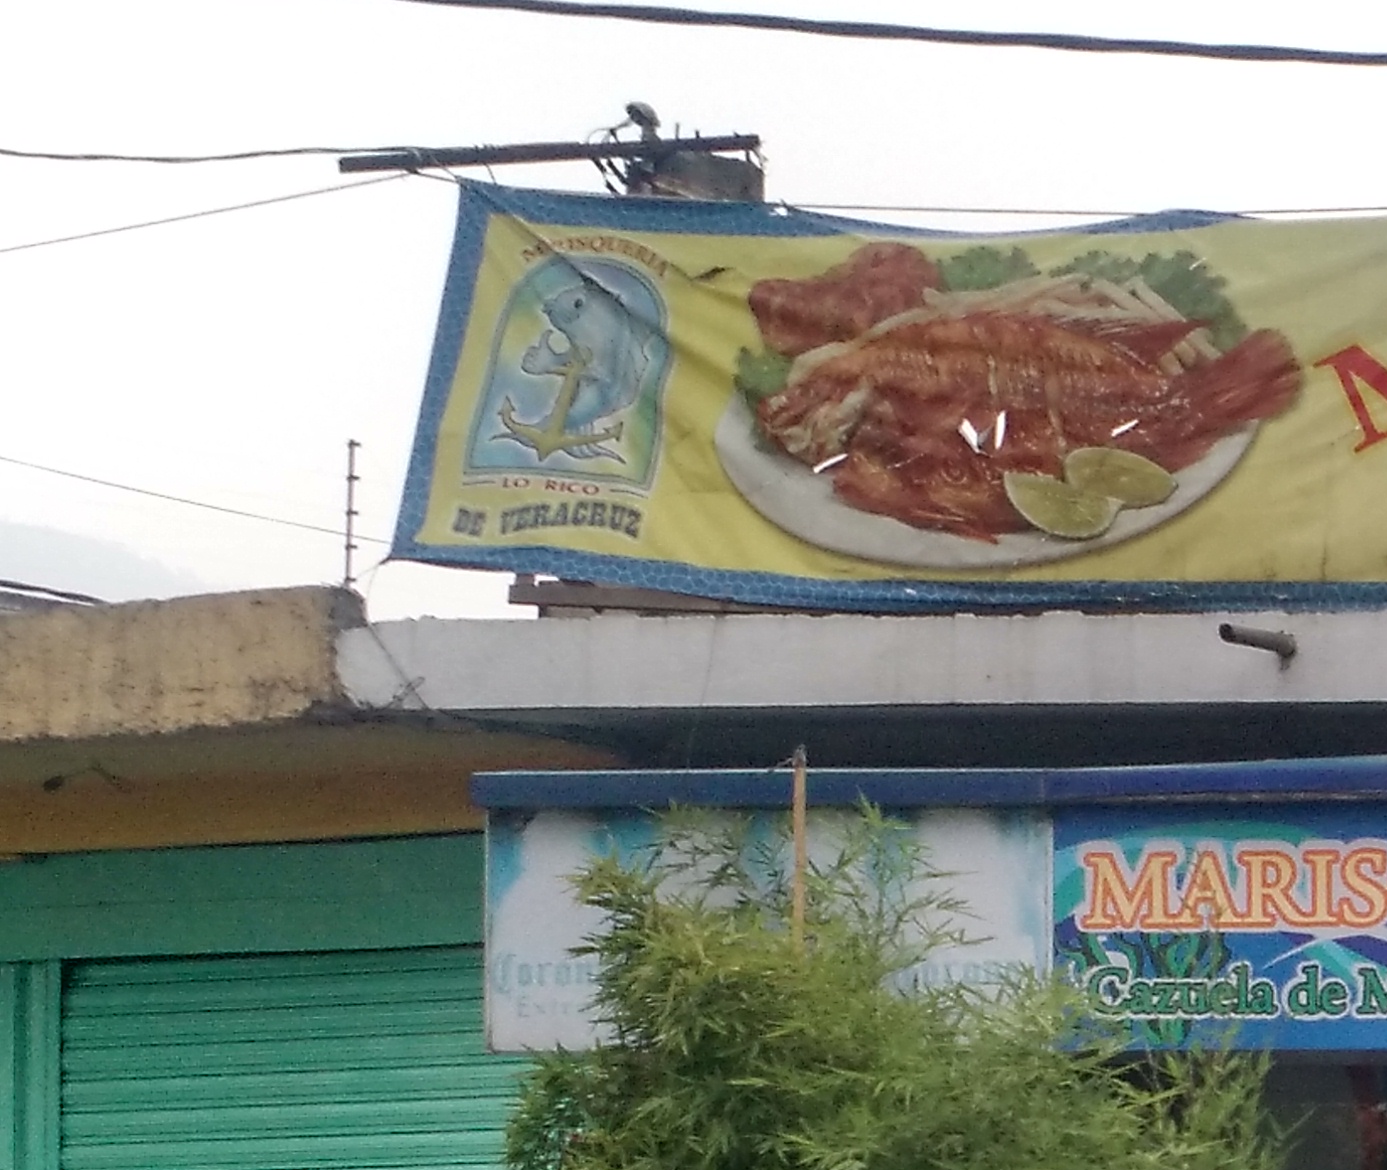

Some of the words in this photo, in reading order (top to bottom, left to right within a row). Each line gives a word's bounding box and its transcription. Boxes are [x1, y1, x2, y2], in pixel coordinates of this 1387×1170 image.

[502, 477, 529, 489] LO
[545, 480, 600, 495] RICO
[453, 507, 487, 537] DE
[501, 501, 643, 539] VERACRUZ
[1088, 961, 1280, 1016] Cazuela
[1288, 963, 1347, 1017] de
